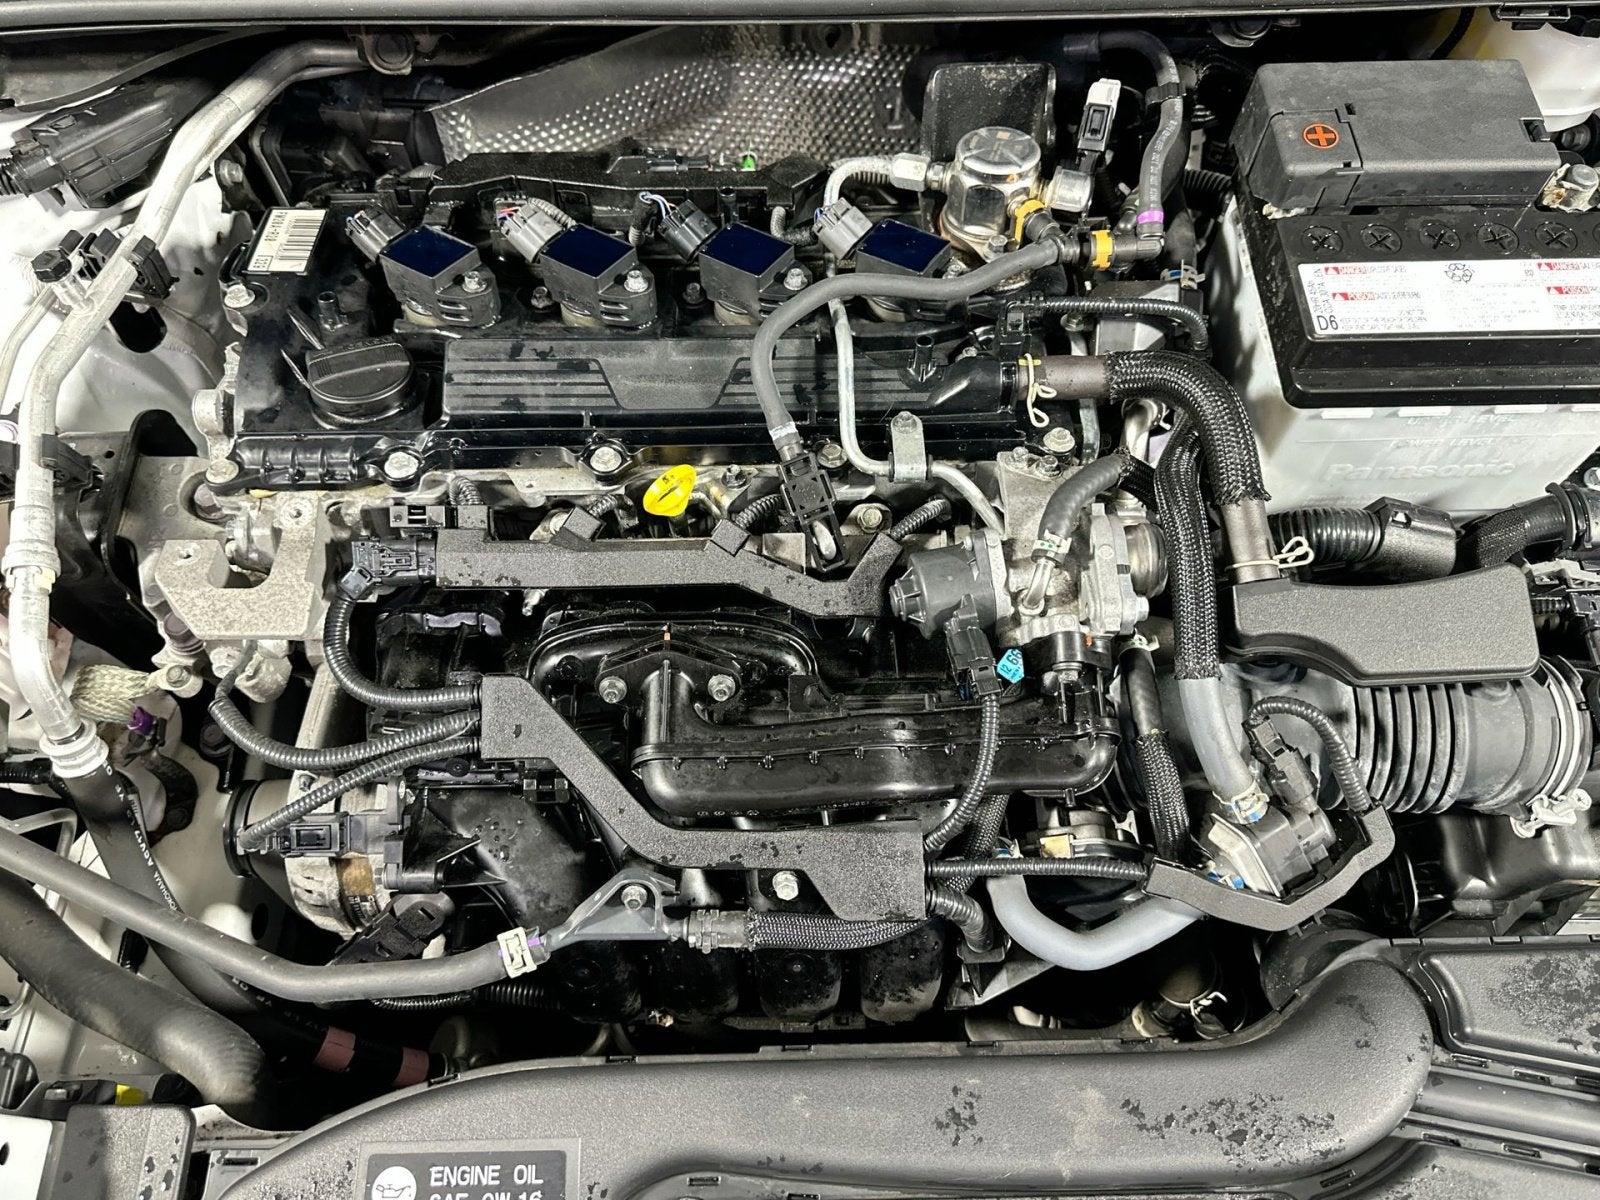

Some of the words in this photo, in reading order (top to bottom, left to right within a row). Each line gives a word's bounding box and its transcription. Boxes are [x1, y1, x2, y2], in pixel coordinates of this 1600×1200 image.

[1317, 315, 1339, 331] D6
[1326, 460, 1516, 481] Panasonic
[429, 1164, 501, 1187] ENGINE
[513, 1164, 544, 1185] OIL
